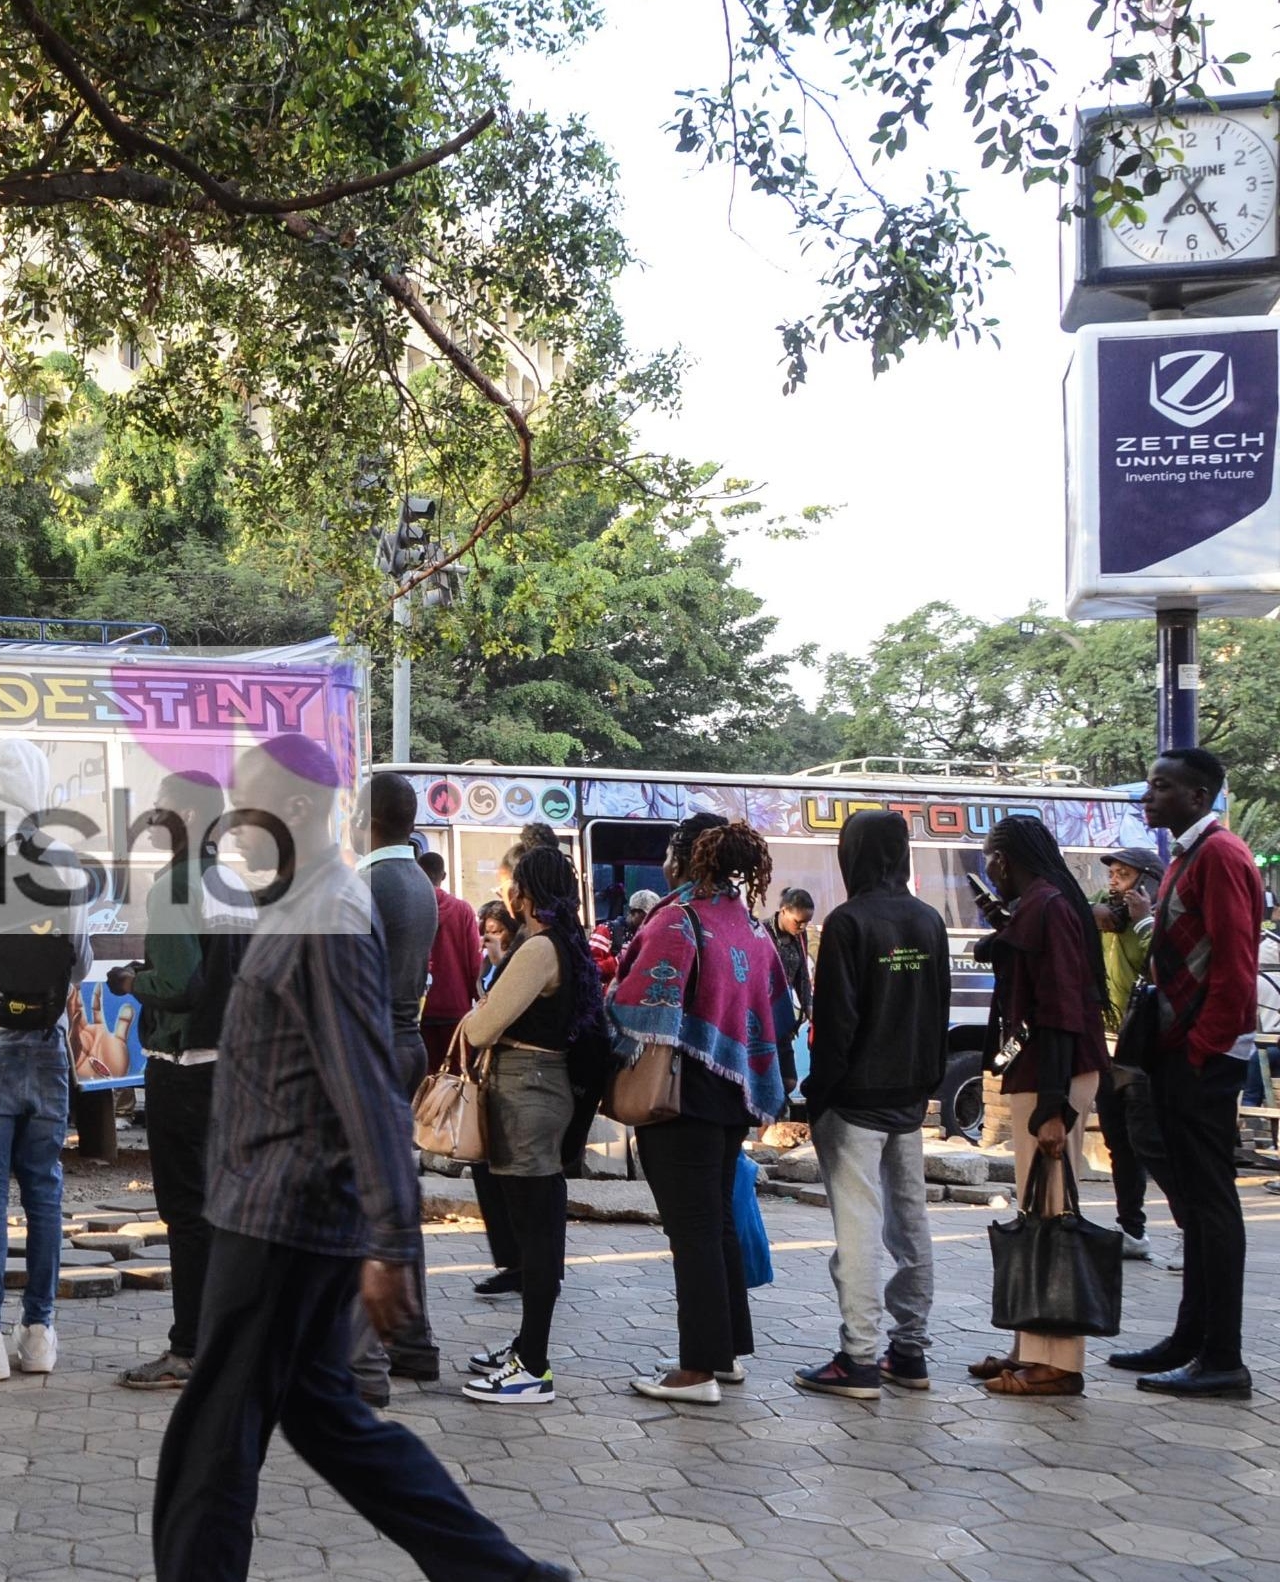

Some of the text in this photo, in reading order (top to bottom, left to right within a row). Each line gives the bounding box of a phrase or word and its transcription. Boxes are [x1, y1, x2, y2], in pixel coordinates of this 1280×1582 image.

[1179, 132, 1197, 149] 12
[1215, 135, 1221, 151] 1
[1234, 150, 1246, 166] 2
[1245, 176, 1258, 192] 3
[1237, 203, 1249, 219] 4
[1157, 229, 1169, 246] 7
[1186, 234, 1198, 250] 6
[1116, 432, 1265, 452] ZETECH
[1116, 452, 1264, 467] UNIVERSITY
[1125, 468, 1255, 483] Inventing the future
[904, 962, 921, 970] YOU
